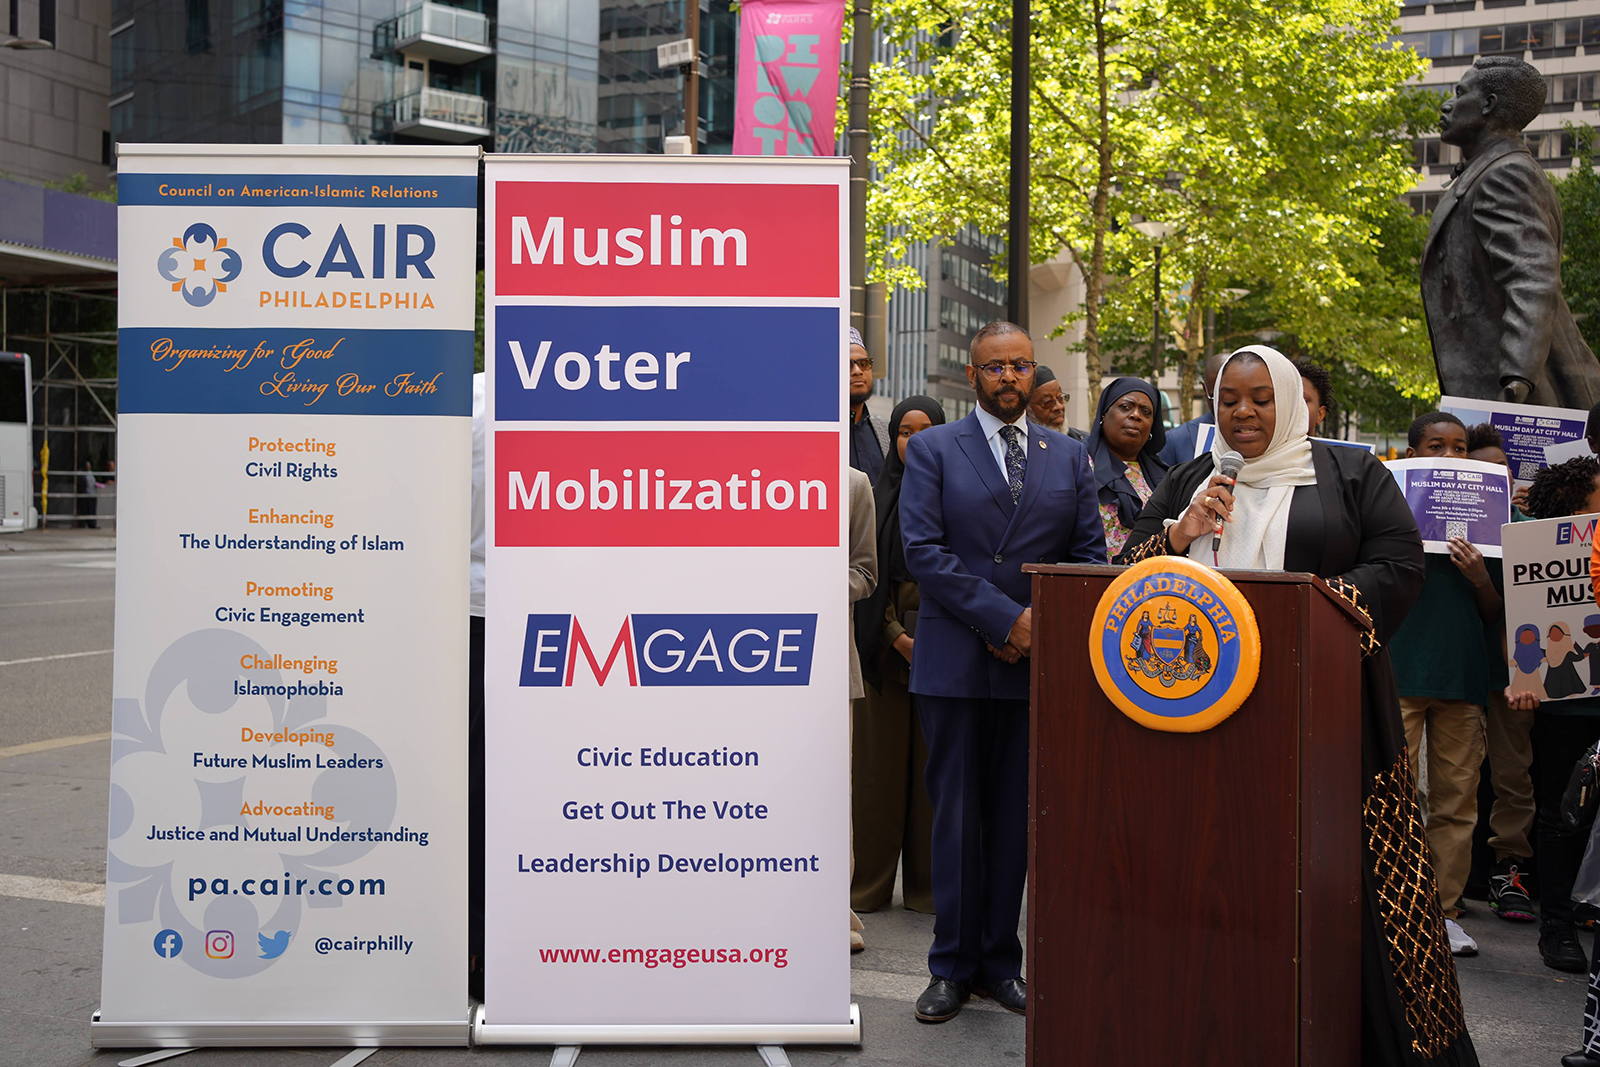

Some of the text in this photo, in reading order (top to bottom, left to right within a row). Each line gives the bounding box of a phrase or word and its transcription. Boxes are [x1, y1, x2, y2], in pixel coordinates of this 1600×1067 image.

[159, 184, 438, 199] Council on American-Islamic Relations
[262, 222, 436, 279] CAIR
[511, 215, 747, 266] Muslim
[260, 291, 435, 309] PHILADELPHIA
[150, 337, 345, 372] Organizing for Good
[508, 341, 690, 390] Voter
[260, 372, 443, 406] Living Our Faith
[1494, 424, 1520, 432] MUSLIM
[249, 437, 336, 457] Protecting
[245, 462, 338, 482] Civil Rights
[509, 469, 827, 511] Mobilization
[249, 508, 334, 528] Enhancing
[179, 534, 404, 554] The Understanding of Islam
[246, 581, 333, 601] Promoting
[215, 607, 365, 626] Civic Engagement
[1106, 577, 1236, 645] PHILADELPHIA
[531, 614, 803, 687] EMGAGE
[240, 654, 338, 674] Challenging
[234, 680, 343, 699] Islamophobia
[241, 727, 335, 747] Developing
[194, 753, 384, 769] Future Muslim Leaders
[577, 747, 759, 767] Civic Education
[240, 801, 335, 820] Advocating
[562, 801, 768, 820] Get Out The Vote
[147, 826, 429, 846] Justice and Mutual Understanding
[518, 853, 819, 878] Leadership Development
[189, 872, 386, 901] pa.cair.com
[315, 935, 414, 955] @cairphilly
[539, 948, 788, 969] www.emgageusa.org
